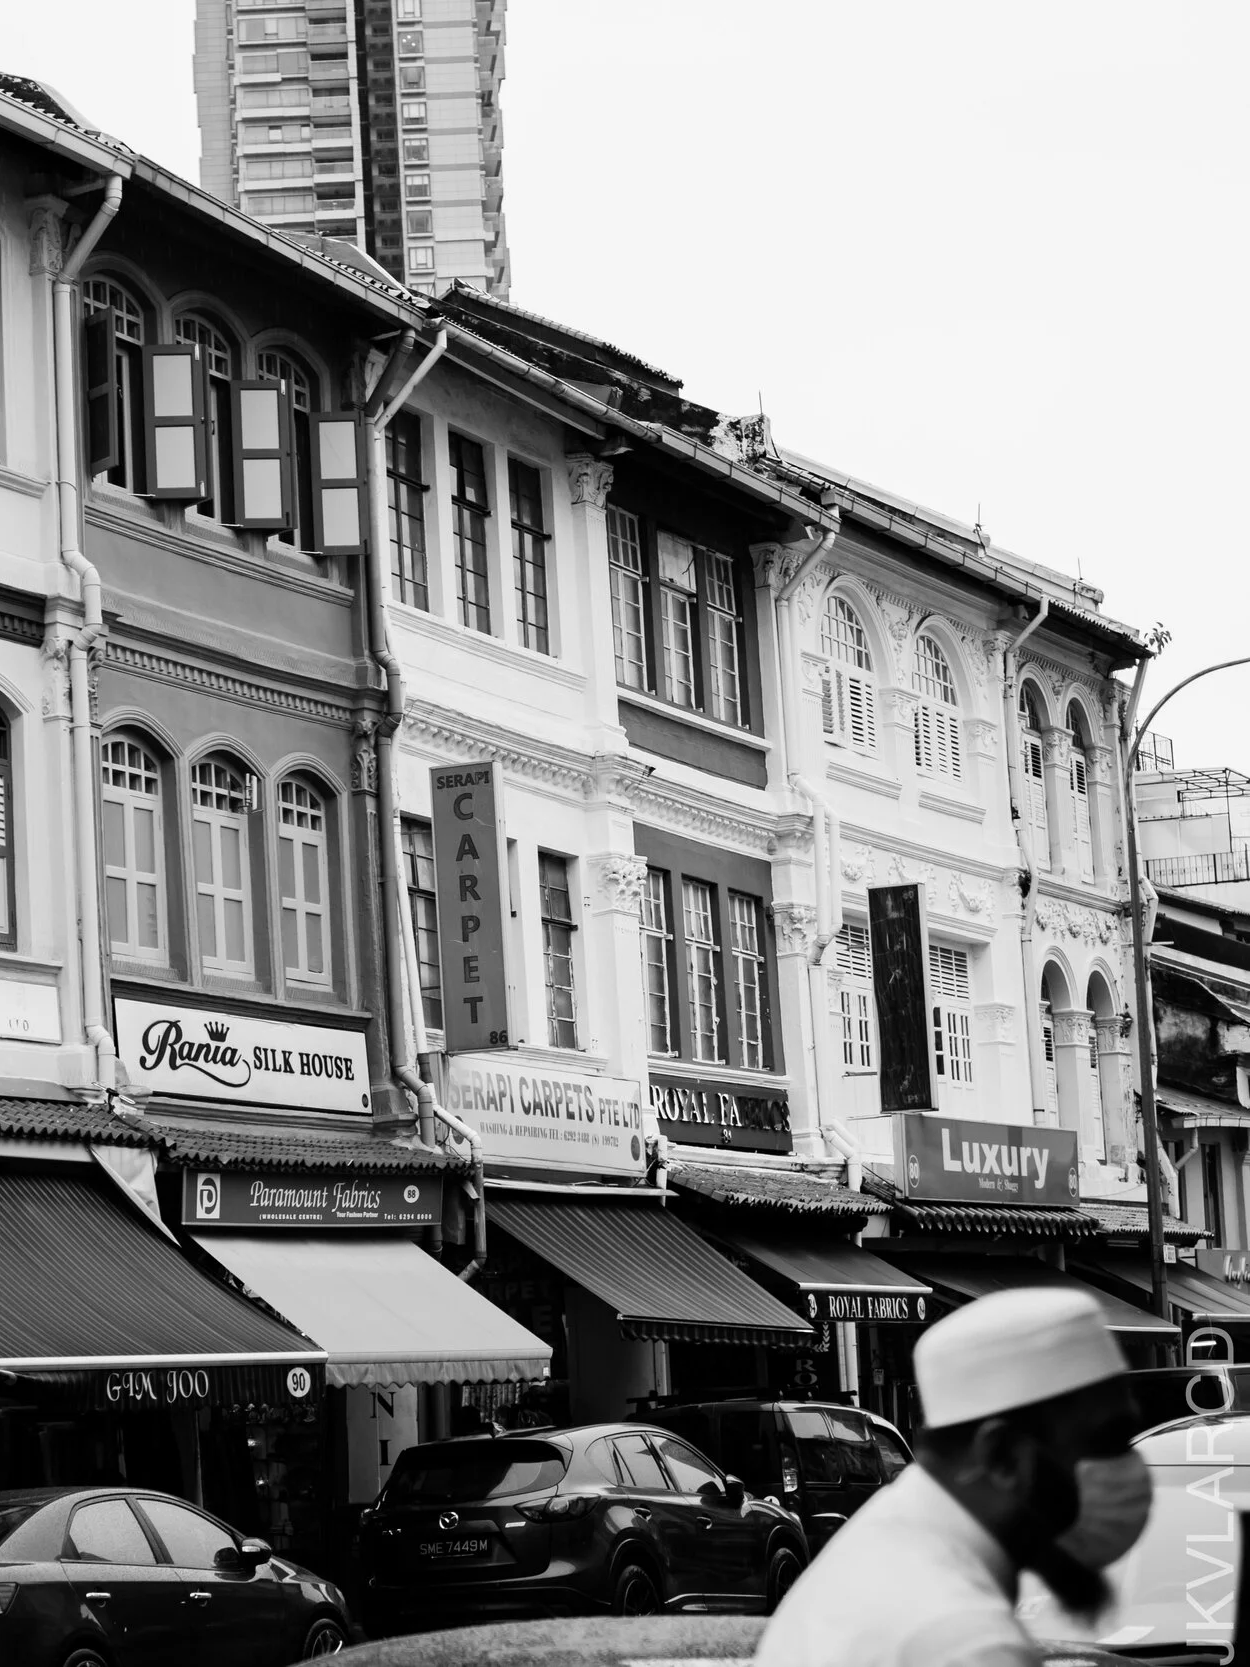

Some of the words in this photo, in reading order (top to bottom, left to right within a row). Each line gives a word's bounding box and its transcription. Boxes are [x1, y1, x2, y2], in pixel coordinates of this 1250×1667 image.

[436, 771, 490, 790] SERAPI
[452, 793, 484, 1024] CARPET
[490, 1029, 508, 1045] 86
[139, 1020, 251, 1088] Rania
[253, 1046, 295, 1075] SILK
[298, 1052, 355, 1081] HOUSE
[449, 1067, 515, 1114] SERAPI
[519, 1075, 595, 1124] CARPETS
[598, 1097, 620, 1127] PTE
[622, 1101, 641, 1130] LTD
[650, 1085, 715, 1124] ROYAL
[941, 1127, 1049, 1189] Luxury
[908, 1161, 918, 1180] 80
[1068, 1174, 1077, 1190] 80
[249, 1180, 329, 1209] Paramount
[331, 1179, 382, 1213] Fabrics
[406, 1189, 417, 1199] 88
[828, 1296, 864, 1318] ROYAL
[867, 1296, 909, 1319] FABRICS
[106, 1372, 157, 1402] GIM
[166, 1370, 209, 1403] JOO
[292, 1372, 306, 1392] 90
[419, 1543, 443, 1555] SME
